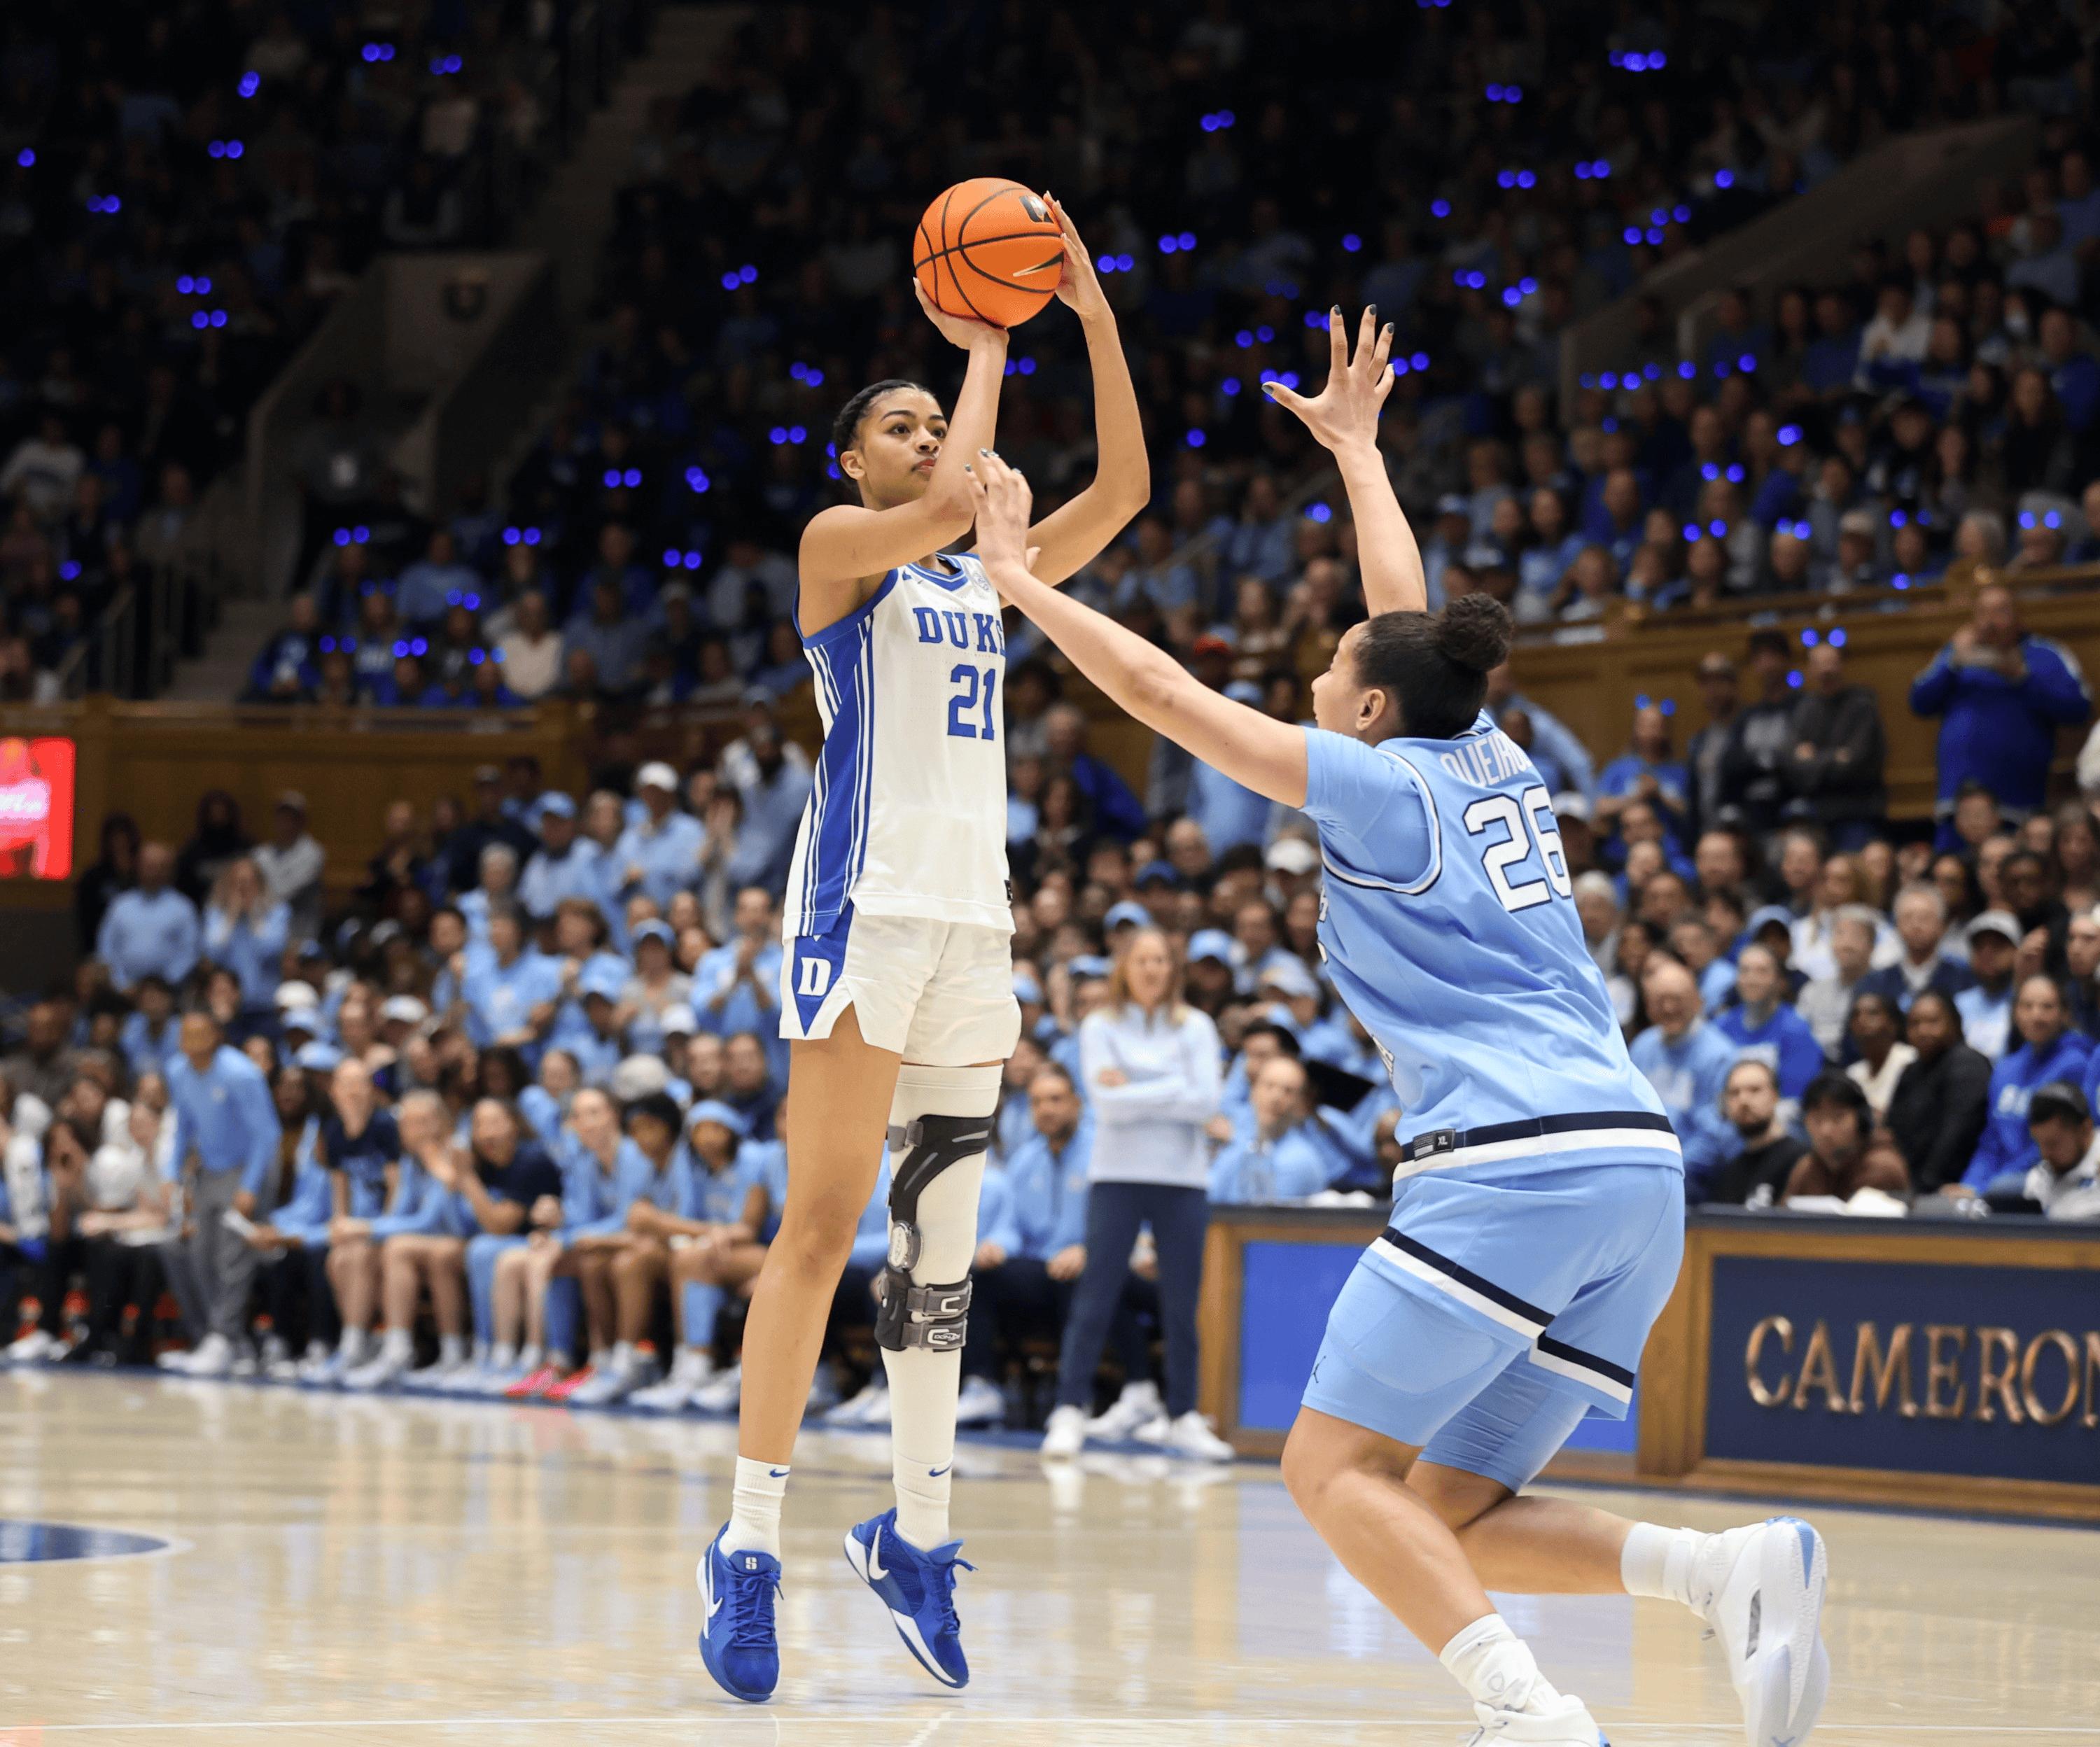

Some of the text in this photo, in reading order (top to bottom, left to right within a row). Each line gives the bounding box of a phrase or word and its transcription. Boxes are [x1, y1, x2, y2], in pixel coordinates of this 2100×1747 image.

[947, 664, 995, 741] 21
[1440, 731, 1532, 788] QUEIRO
[1462, 783, 1572, 913] 26
[797, 957, 831, 997] D
[1438, 1135, 1448, 1146] XL
[1746, 1314, 2100, 1428] CAMERO
